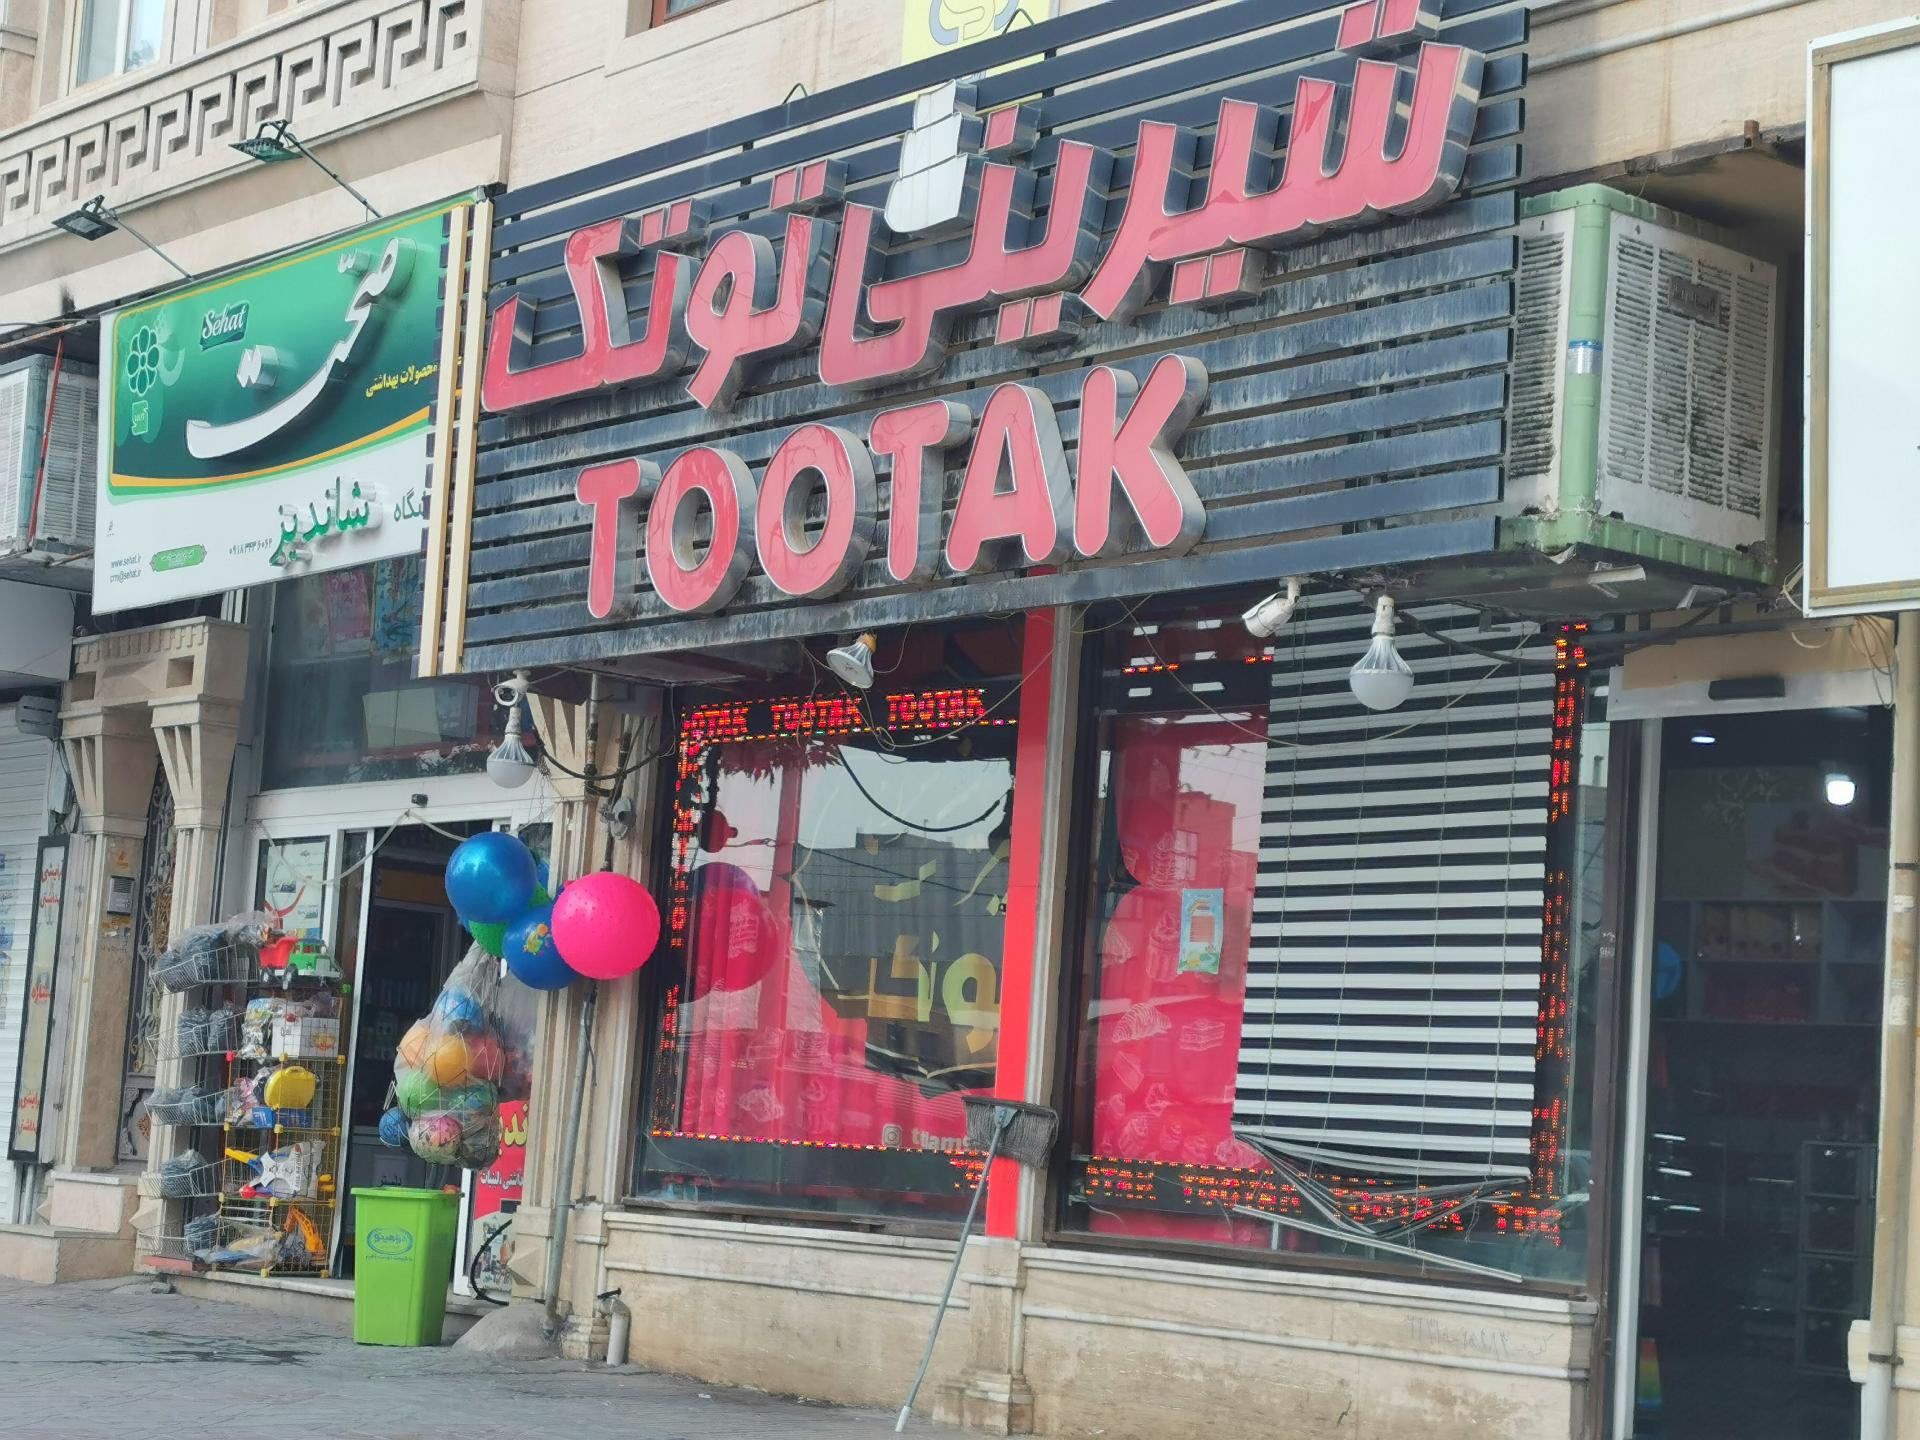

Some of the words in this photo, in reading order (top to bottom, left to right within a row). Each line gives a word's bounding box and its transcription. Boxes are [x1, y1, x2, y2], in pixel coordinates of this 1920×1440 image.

[482, 160, 834, 411] توتک
[819, 0, 1465, 383] شیرینی
[202, 303, 247, 340] Sehat
[269, 476, 370, 566] شاندیز
[575, 353, 1203, 619] TOOTAK
